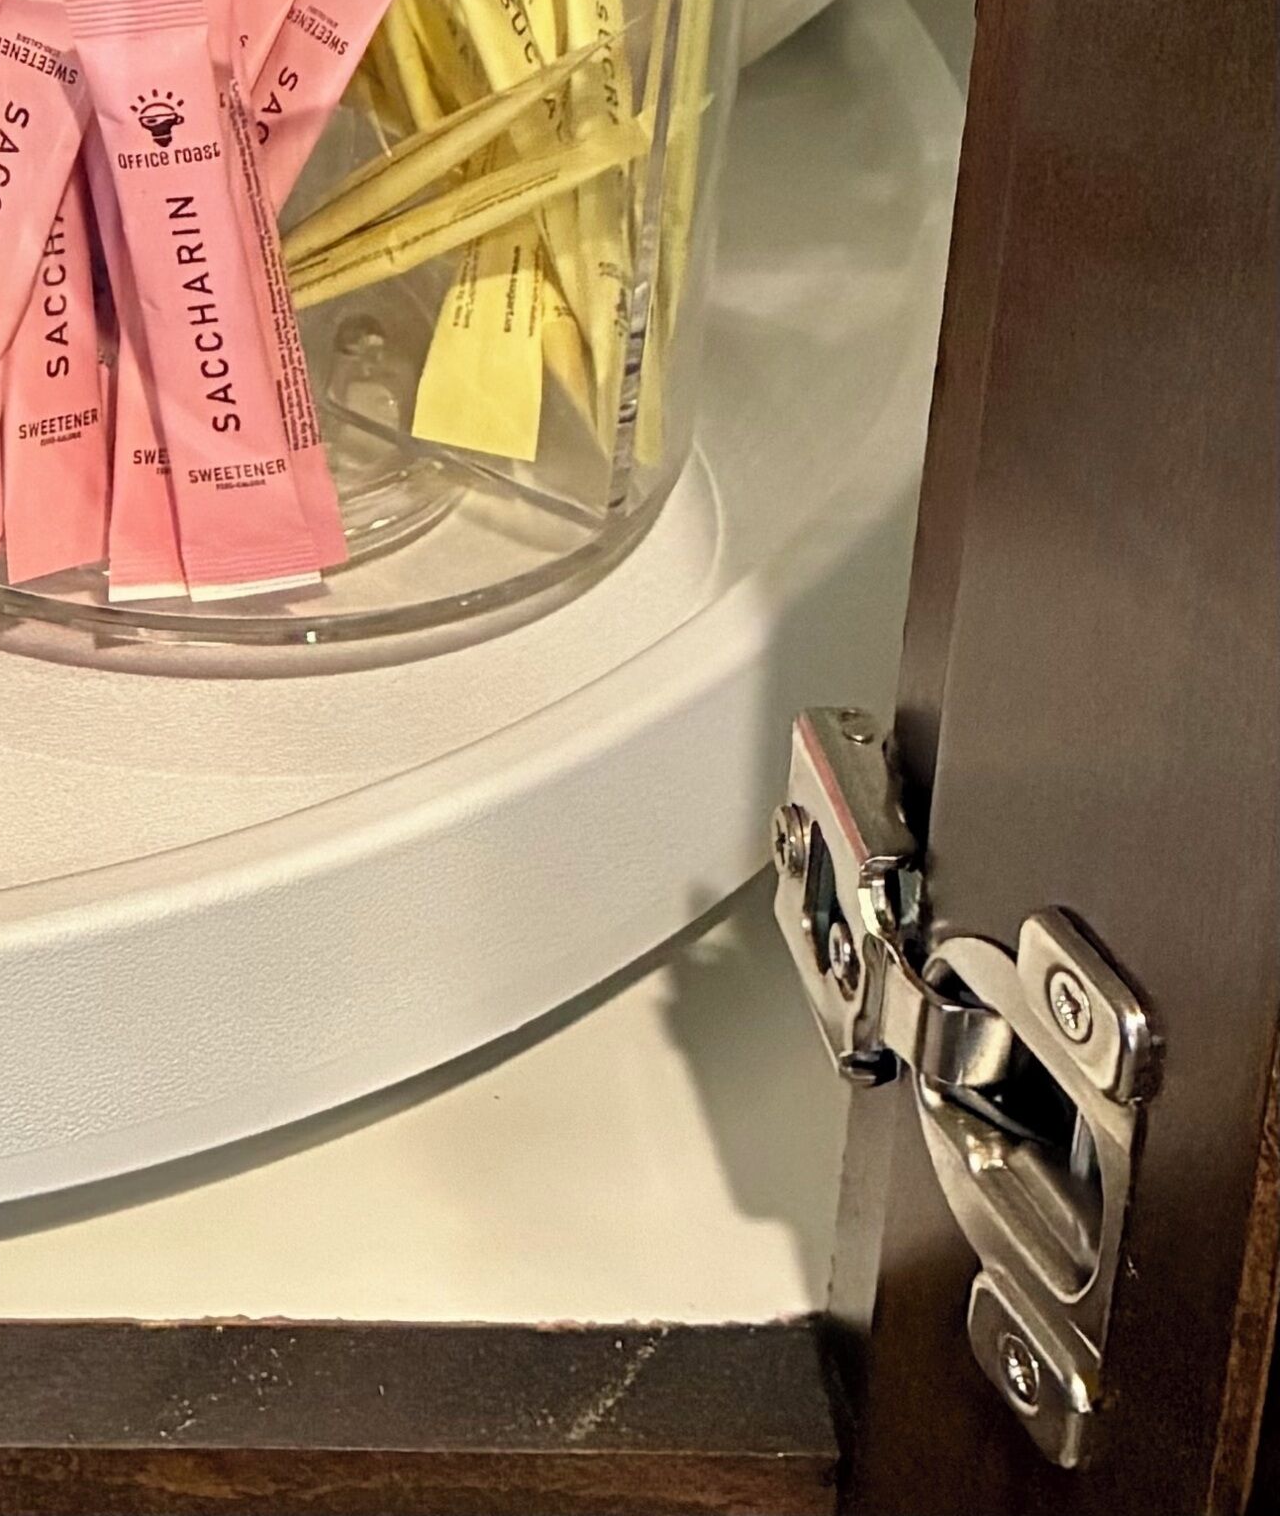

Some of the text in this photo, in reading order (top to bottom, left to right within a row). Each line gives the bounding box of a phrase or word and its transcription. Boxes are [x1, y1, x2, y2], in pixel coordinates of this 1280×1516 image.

[165, 196, 241, 433] SACCHARIN
[18, 408, 99, 440] SWEETENER
[188, 457, 287, 484] SWEETENER
